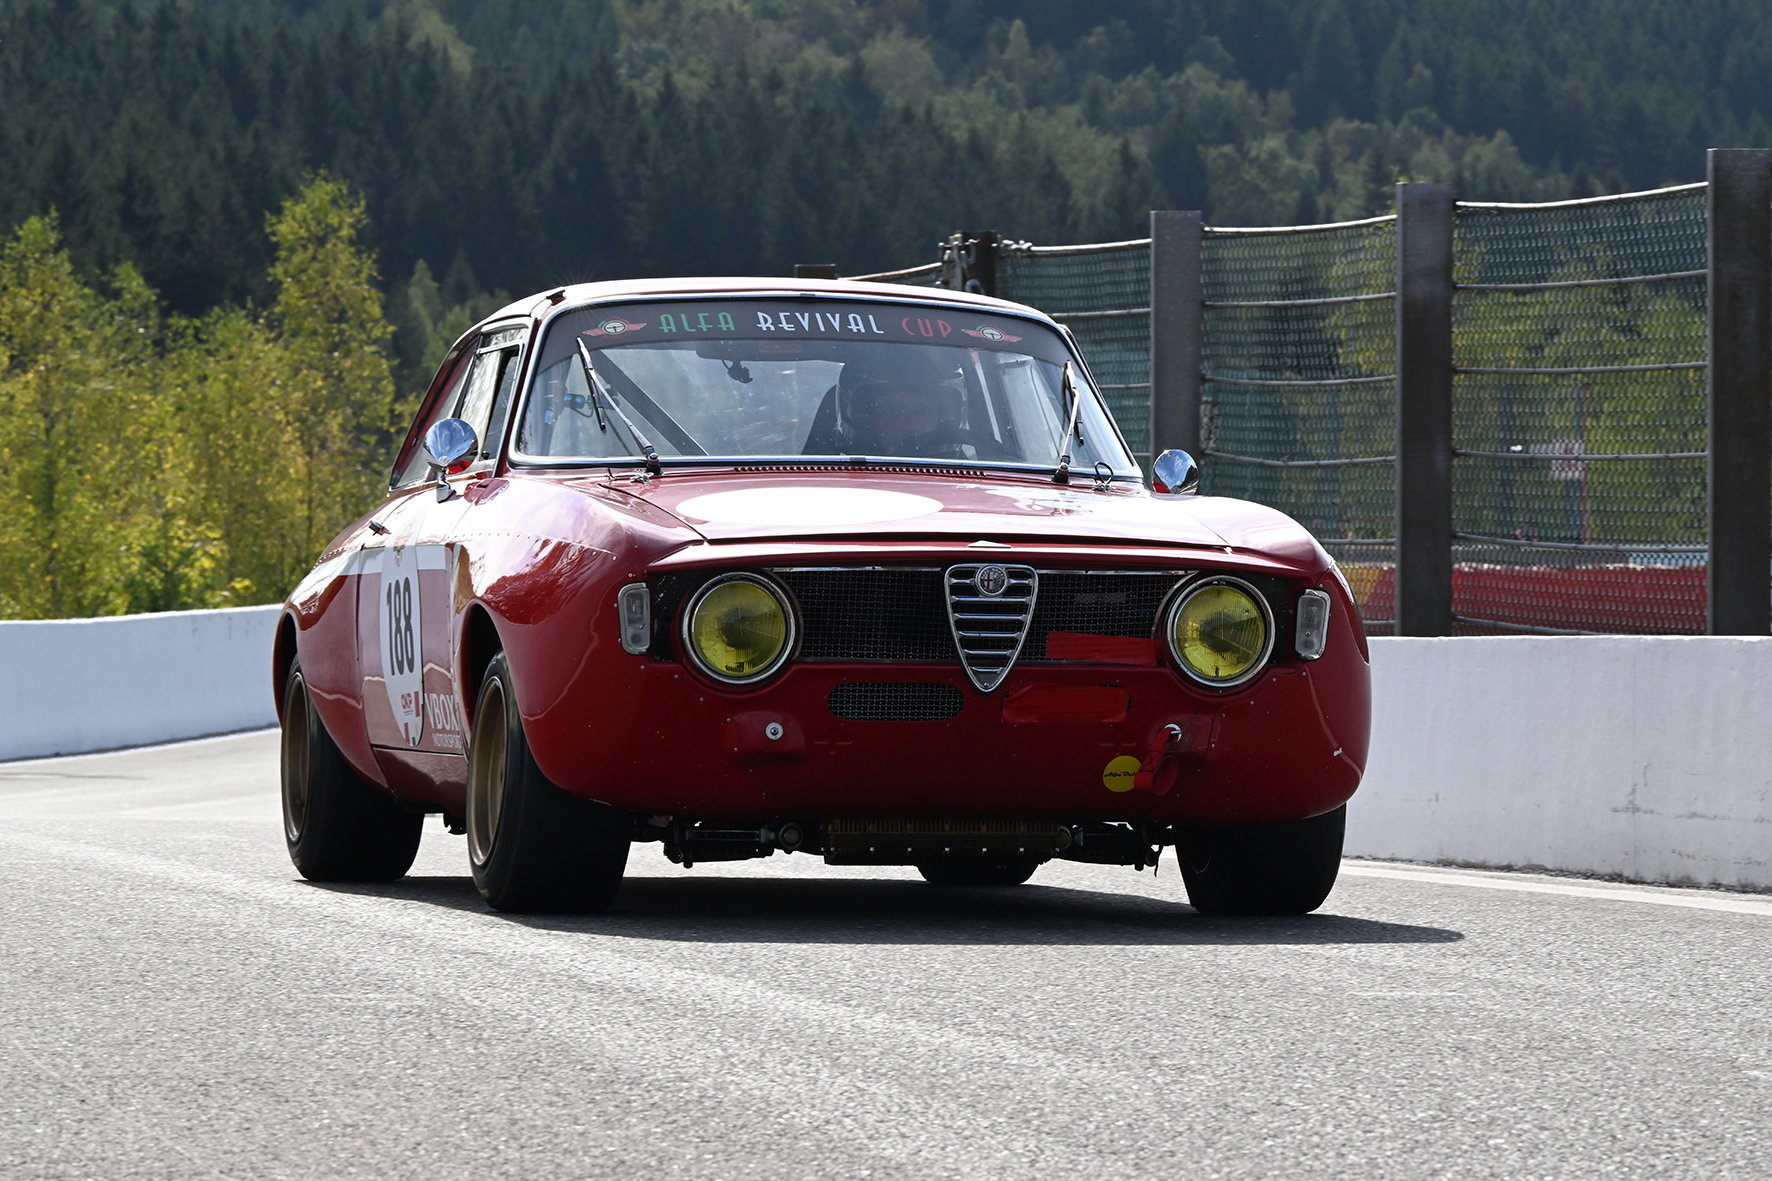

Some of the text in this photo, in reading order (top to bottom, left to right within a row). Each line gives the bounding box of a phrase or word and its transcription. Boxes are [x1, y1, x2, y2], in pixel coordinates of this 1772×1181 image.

[658, 311, 952, 339] ALFA REVIVAL CUP
[386, 576, 415, 676] 188
[424, 692, 460, 731] VBOX
